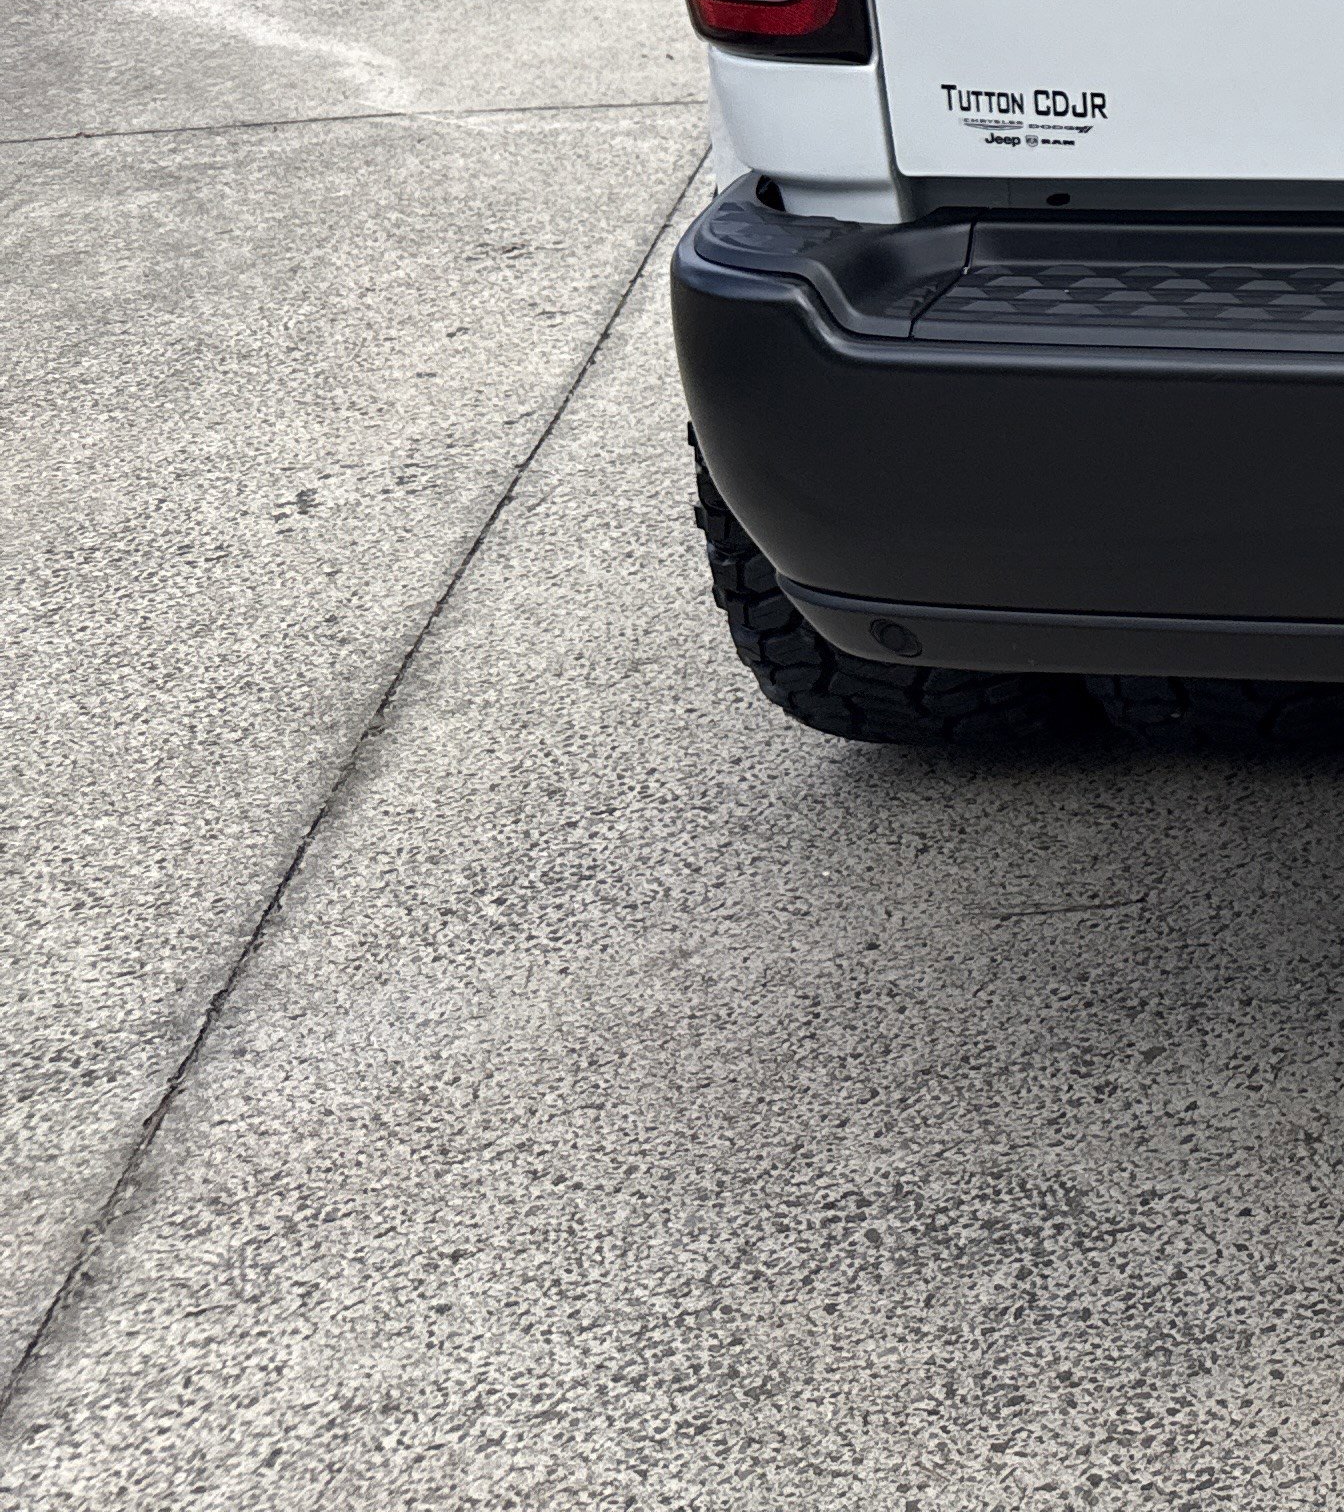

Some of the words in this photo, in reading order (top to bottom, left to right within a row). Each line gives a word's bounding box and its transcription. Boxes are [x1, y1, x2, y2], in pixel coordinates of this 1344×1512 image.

[1033, 88, 1108, 119] CDJR
[984, 132, 1021, 147] Jeep
[1040, 138, 1075, 146] RAM
